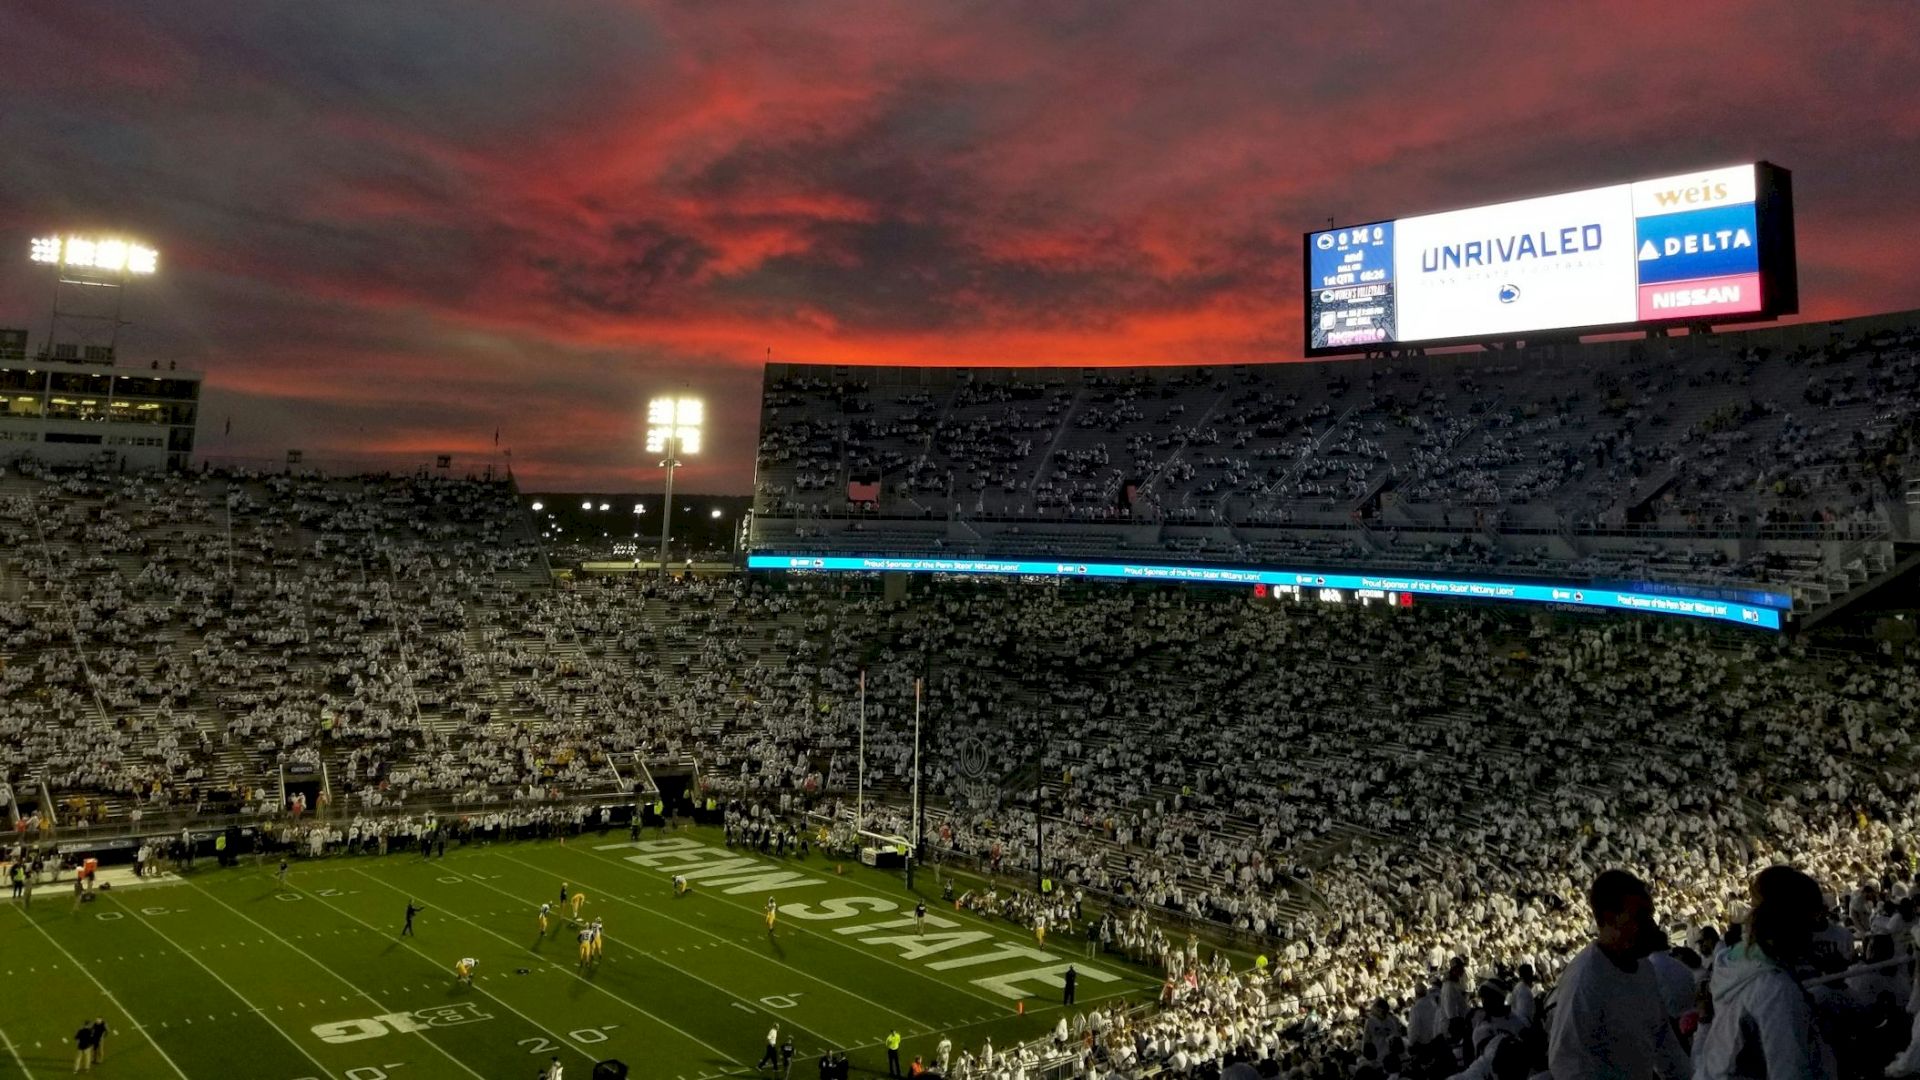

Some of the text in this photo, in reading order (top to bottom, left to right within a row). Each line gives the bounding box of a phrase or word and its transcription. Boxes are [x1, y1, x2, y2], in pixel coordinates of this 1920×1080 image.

[1654, 179, 1728, 207] weis
[1352, 228, 1368, 244] M
[1373, 227, 1382, 240] 0
[1664, 228, 1751, 256] DELTA
[1422, 224, 1602, 273] UNRIVALED
[1652, 286, 1740, 309] NISSAN
[864, 560, 884, 568] Proud
[886, 560, 912, 569] Sponsor
[914, 560, 922, 568] of
[922, 560, 934, 568] the
[935, 561, 953, 569] Penn
[1124, 567, 1142, 575] Proud
[1144, 568, 1168, 577] Sponsor
[1169, 568, 1176, 576] of
[1362, 578, 1381, 587] Proud
[1382, 579, 1409, 590] Sponsor
[1410, 580, 1418, 589] of
[1419, 581, 1430, 590] the
[1431, 582, 1448, 591] Penn
[1470, 584, 1495, 596] Nittany
[592, 838, 827, 894] PENN
[778, 896, 1123, 1000] STATE
